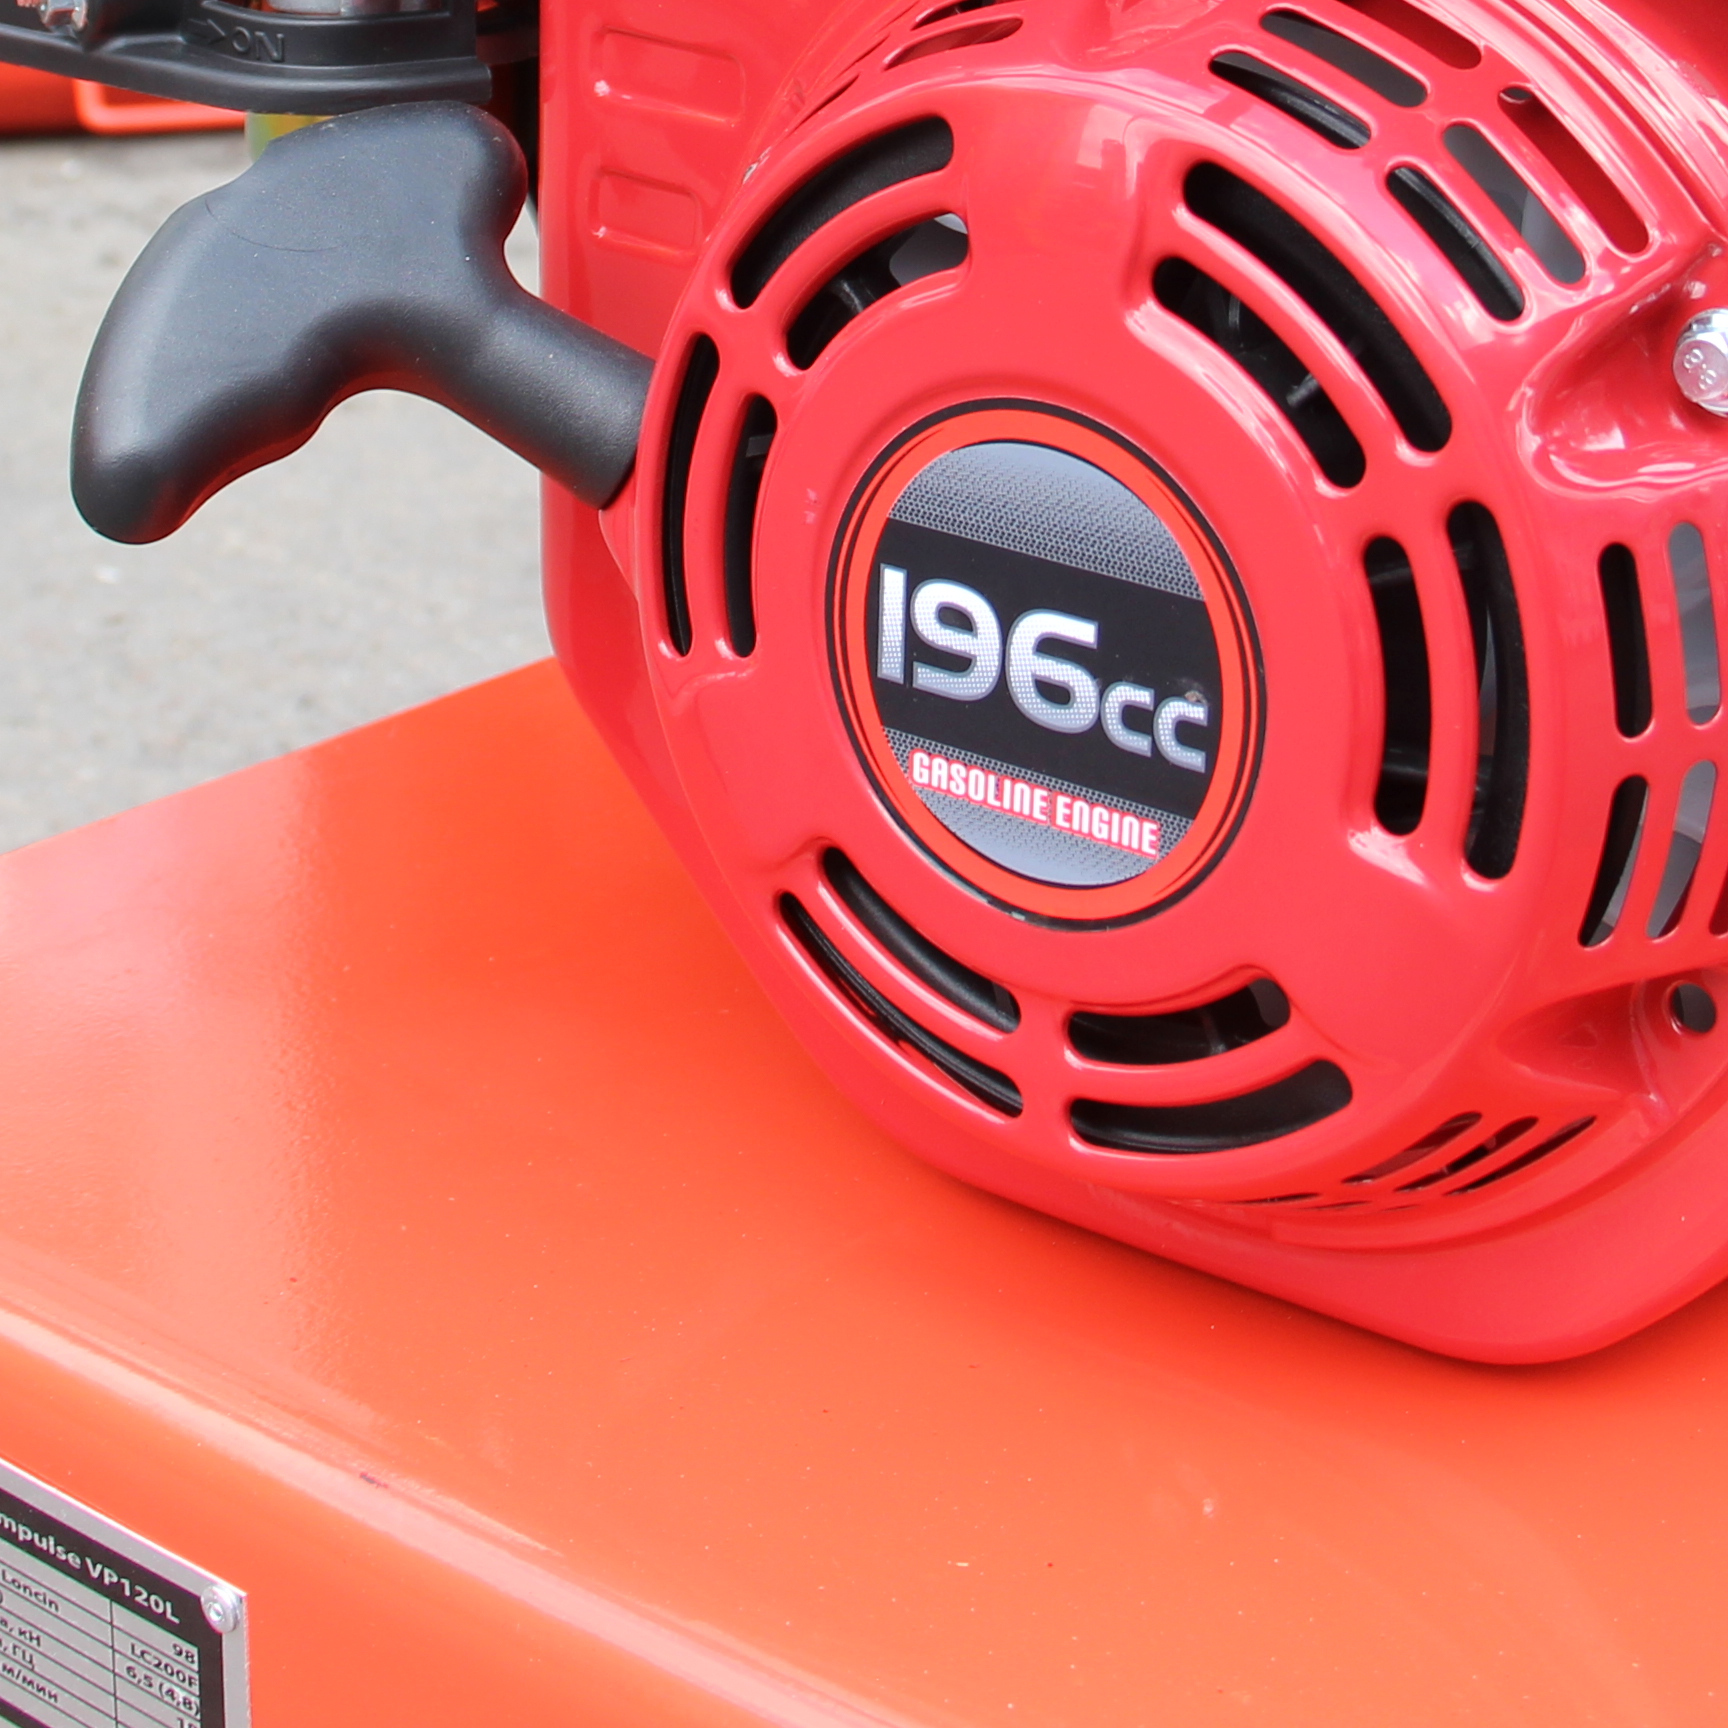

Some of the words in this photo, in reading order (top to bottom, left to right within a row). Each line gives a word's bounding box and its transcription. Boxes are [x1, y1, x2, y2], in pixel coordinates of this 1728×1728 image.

[876, 563, 1209, 773] 196cc
[912, 751, 1049, 823] GASOLINE
[1055, 796, 1159, 856] ENGINE
[2, 1569, 60, 1613] Loncin
[85, 1557, 181, 1625] VP120L
[130, 1642, 198, 1688] LC200F
[172, 1643, 196, 1664] 98
[126, 1665, 154, 1689] 6,5
[159, 1681, 200, 1716] (4,8)
